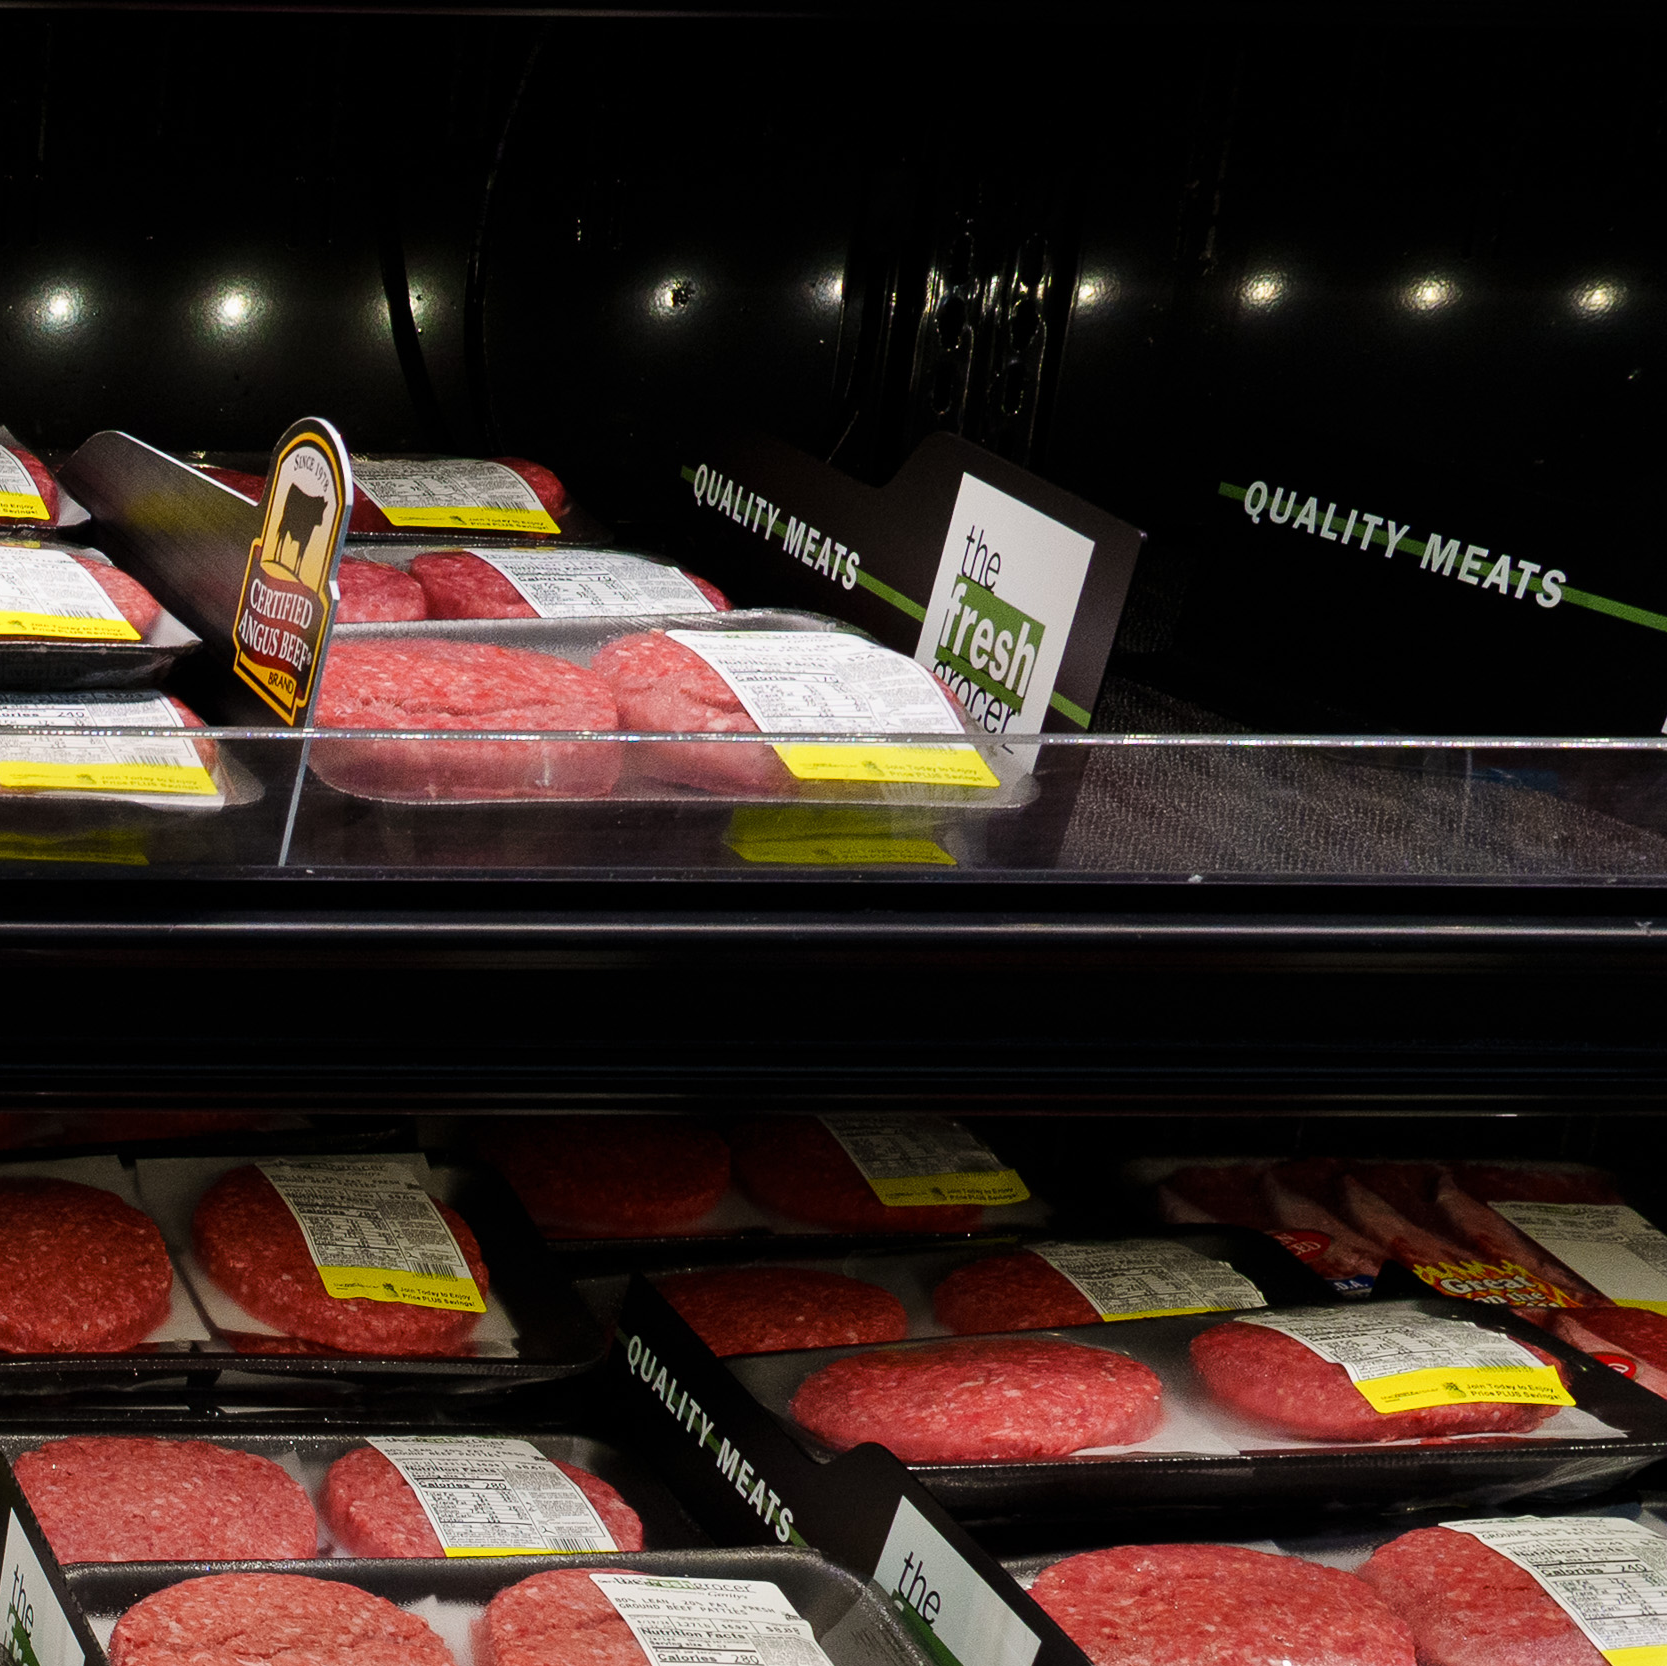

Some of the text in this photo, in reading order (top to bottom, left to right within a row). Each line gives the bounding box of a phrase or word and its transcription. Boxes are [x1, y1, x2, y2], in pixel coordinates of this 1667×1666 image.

[293, 453, 316, 476] SINCE
[314, 461, 330, 493] 1978
[693, 464, 781, 541] QUALITY
[782, 516, 861, 591] MEATS
[961, 525, 1001, 588] the
[1244, 481, 1567, 608] QUALITY MEATS
[238, 610, 277, 656] ANGUS
[250, 578, 314, 630] CERTIFIED
[939, 582, 1035, 699] fresh
[268, 666, 295, 696] BRAND
[627, 1335, 793, 1542] QUALITY MEATS
[12, 1563, 36, 1640] the
[897, 1551, 941, 1627] the
[657, 1652, 718, 1663] Calories
